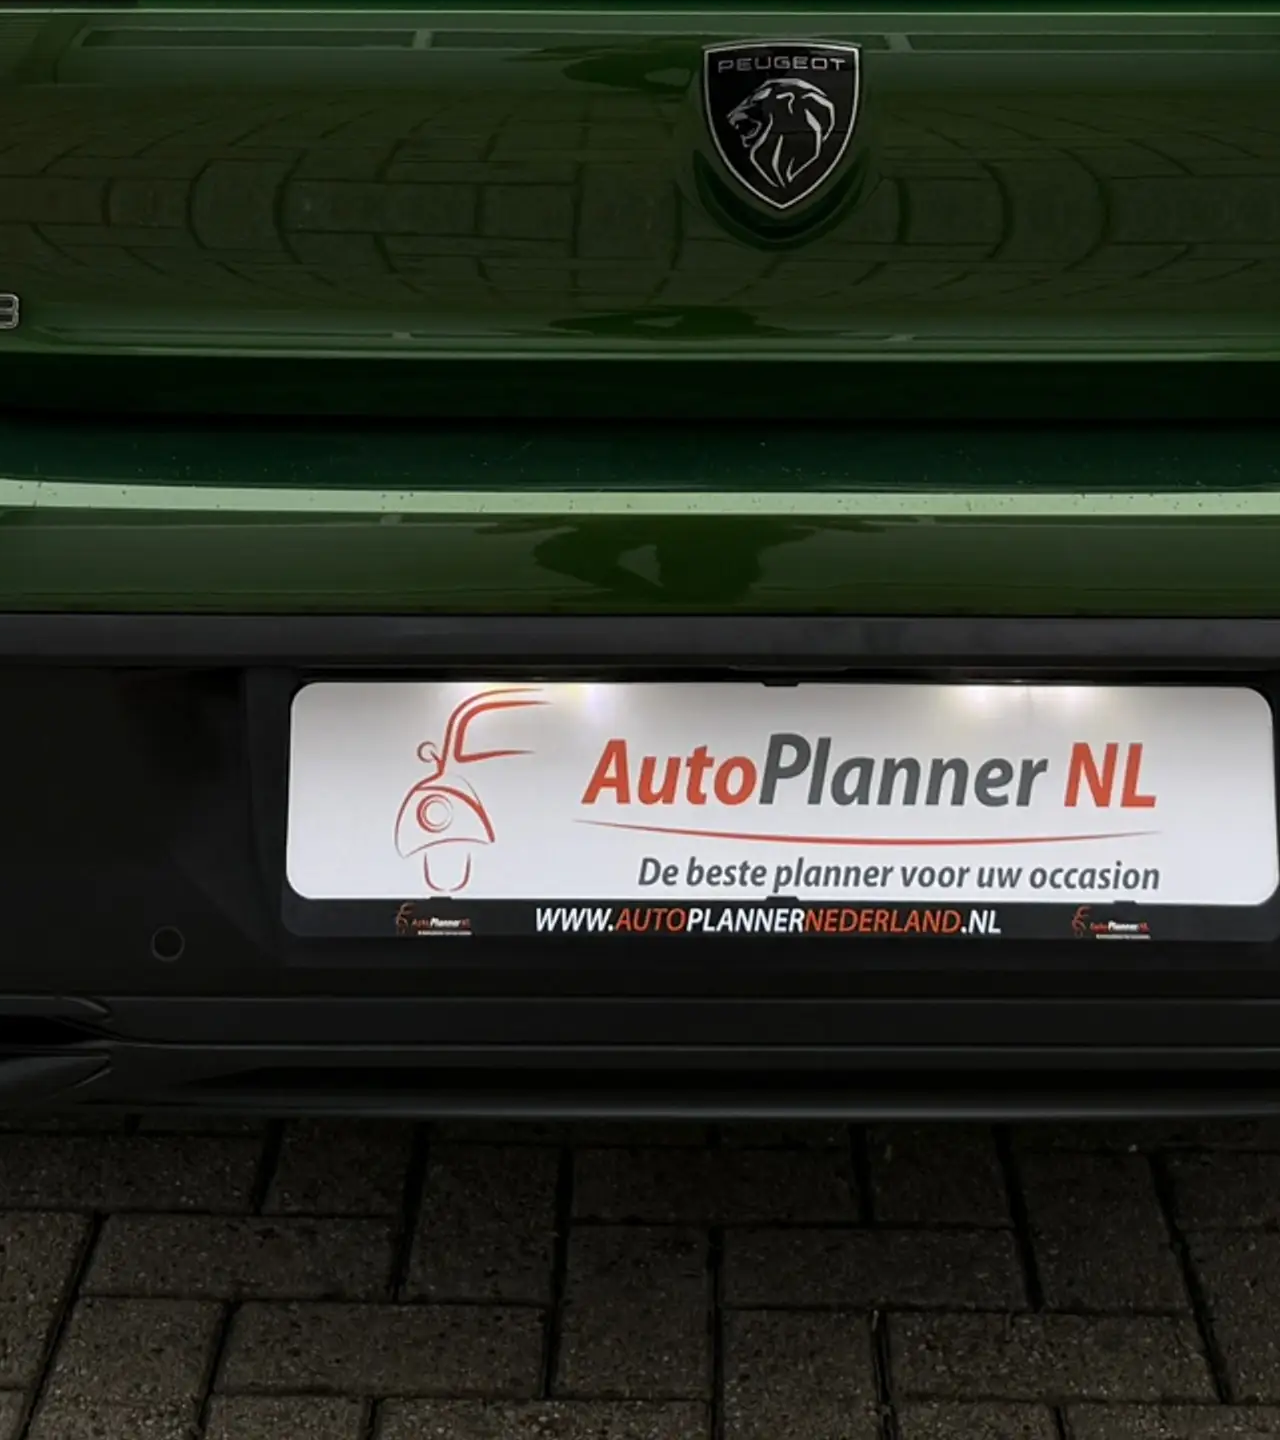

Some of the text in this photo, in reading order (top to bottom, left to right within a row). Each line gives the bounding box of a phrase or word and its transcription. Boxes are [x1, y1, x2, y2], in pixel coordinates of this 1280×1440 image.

[717, 55, 846, 73] PEUGEOT
[581, 733, 1158, 808] AutoPlanner NL
[638, 856, 1160, 894] De beste planner voor uw occasion
[535, 907, 1002, 935] WWW.AUTOPLANNERNEDERLAND.NL
